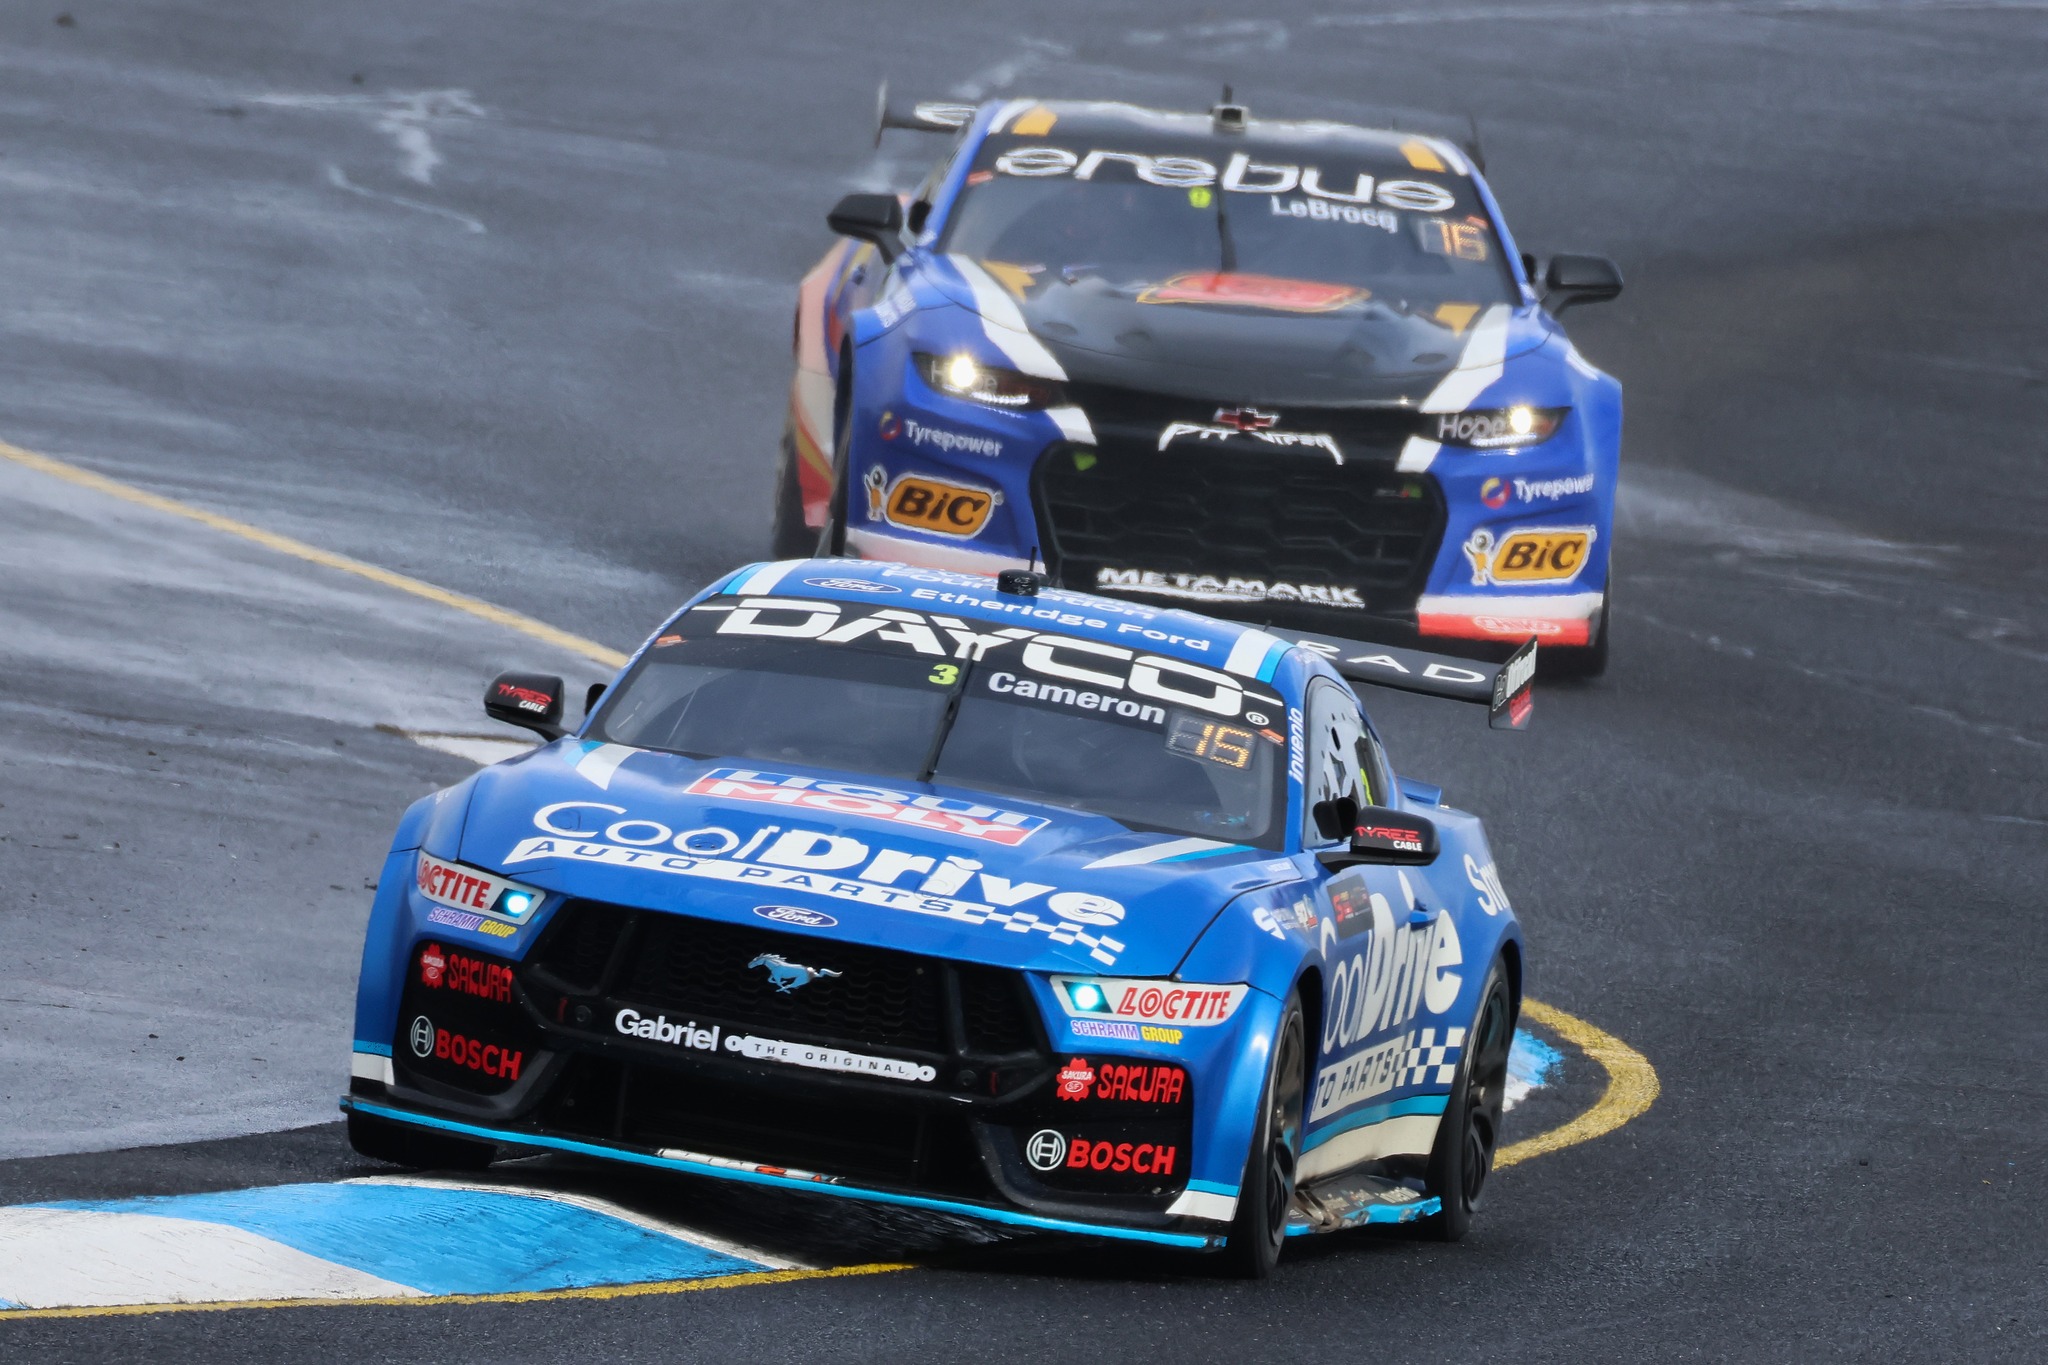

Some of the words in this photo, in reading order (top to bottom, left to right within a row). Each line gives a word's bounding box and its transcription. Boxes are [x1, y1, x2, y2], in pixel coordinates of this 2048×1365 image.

[1271, 195, 1397, 234] LeBrocq
[904, 419, 1003, 457] Tyrepower
[883, 569, 1154, 621] Founation
[1098, 566, 1362, 606] METAMARK
[910, 588, 1108, 630] Etheridge
[1117, 622, 1211, 651] Ford
[715, 598, 1244, 717] DAYCO
[928, 663, 959, 685] 3
[519, 700, 546, 713] CABLE
[988, 671, 1166, 725] Cameron
[1195, 723, 1253, 769] 15
[1288, 707, 1304, 785] invenio
[708, 781, 1017, 836] MOLY
[725, 769, 1031, 828] LIQUI
[532, 799, 1126, 927] CoolDrive
[1393, 840, 1423, 852] CABLE
[524, 840, 699, 871] AUTO
[737, 867, 956, 913] PARTS
[427, 906, 484, 931] SCHRAMM
[478, 919, 517, 938] GROUP
[448, 953, 514, 1003] SAKURA
[1115, 987, 1231, 1020] LOCTITE
[614, 1008, 720, 1052] Gabriel
[1071, 1020, 1140, 1040] SCHRAMM
[1141, 1025, 1183, 1044] GROUP
[435, 1028, 523, 1081] BOSCH
[754, 1042, 789, 1057] THE
[804, 1051, 906, 1075] ORIGINAL
[1061, 1069, 1093, 1081] SAKURA
[1338, 1047, 1394, 1101] PARTS
[1096, 1063, 1186, 1104] SAKURA
[1066, 1139, 1176, 1175] BOSCH
